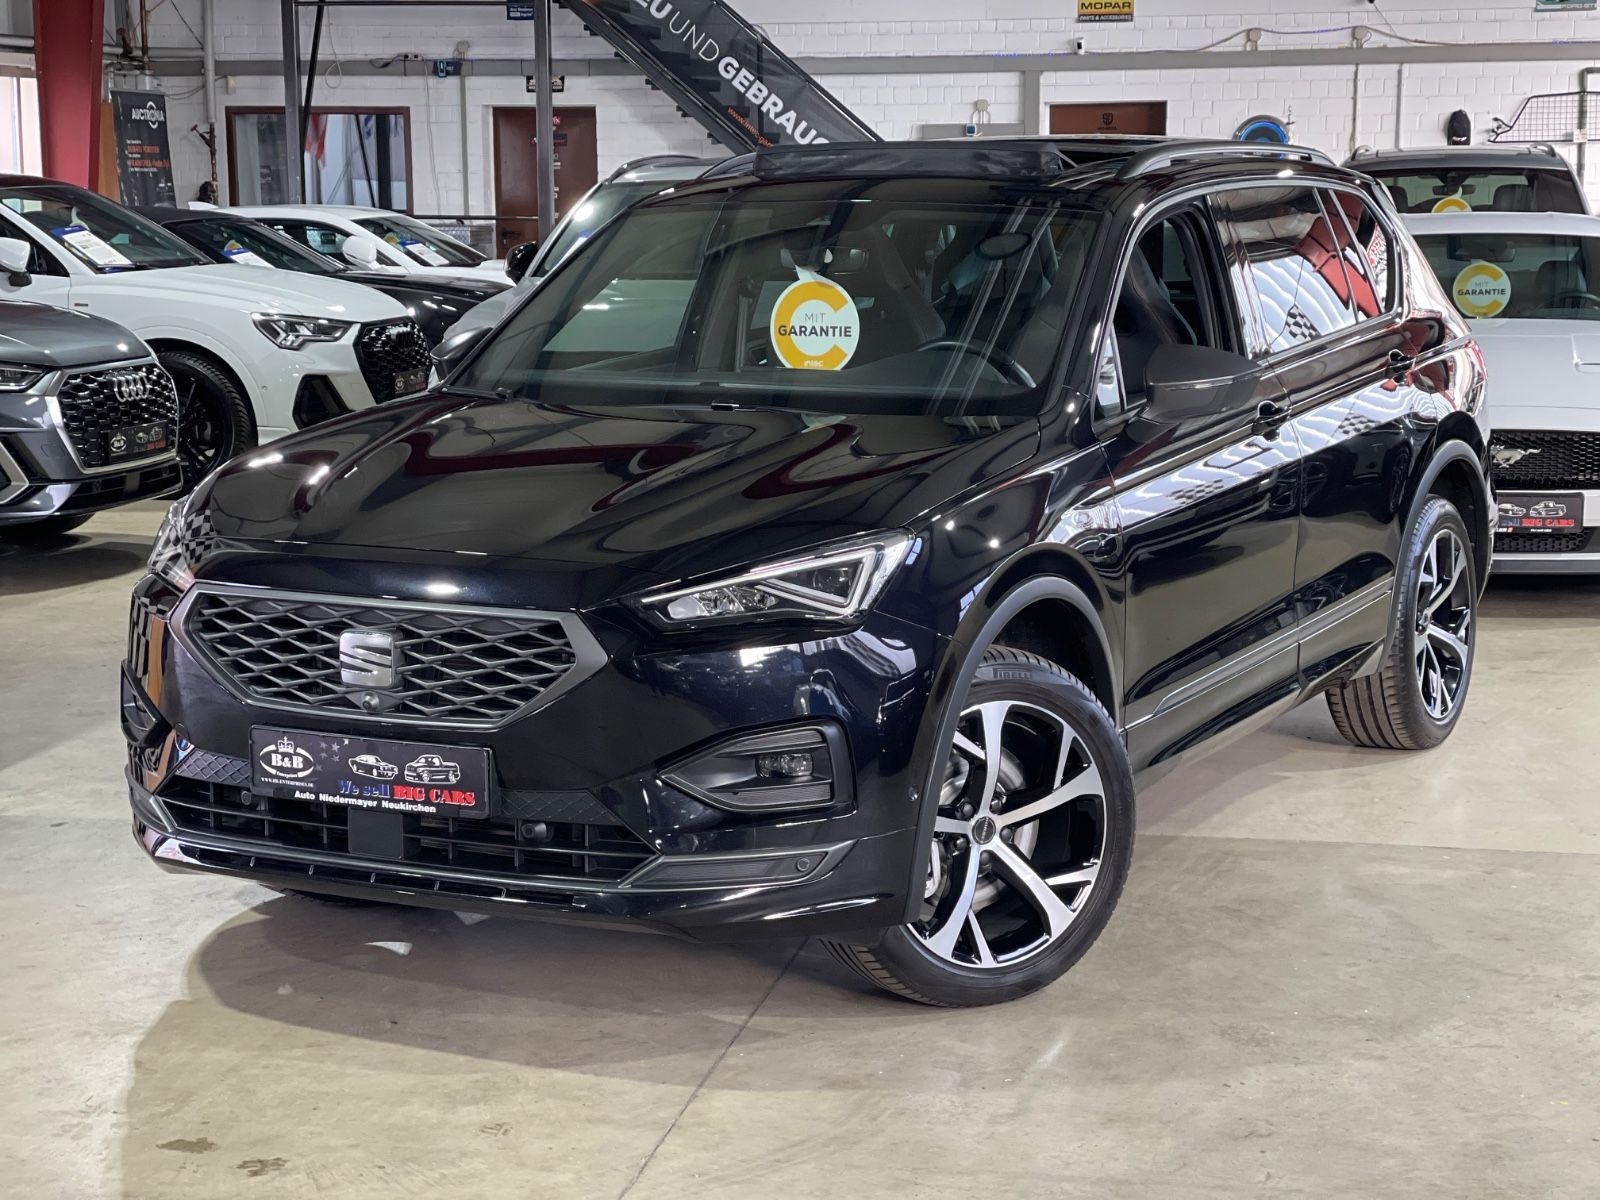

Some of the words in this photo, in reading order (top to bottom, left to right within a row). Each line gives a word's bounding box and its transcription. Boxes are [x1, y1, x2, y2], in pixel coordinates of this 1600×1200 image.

[1080, 2, 1131, 10] MOPAR
[669, 11, 719, 61] UND
[1457, 288, 1506, 296] GARANTIE
[804, 312, 826, 323] MIT
[778, 325, 852, 337] GARANTIE
[1544, 518, 1575, 527] CARS
[992, 667, 1033, 679] PIRELLI
[271, 753, 304, 769] B&B
[336, 779, 360, 795] We
[362, 784, 391, 798] sell
[393, 785, 425, 801] BIG
[429, 788, 475, 806] CARS
[294, 790, 316, 801] Auto
[319, 793, 378, 808] Niedermayer
[381, 799, 437, 813] Neukirchen
